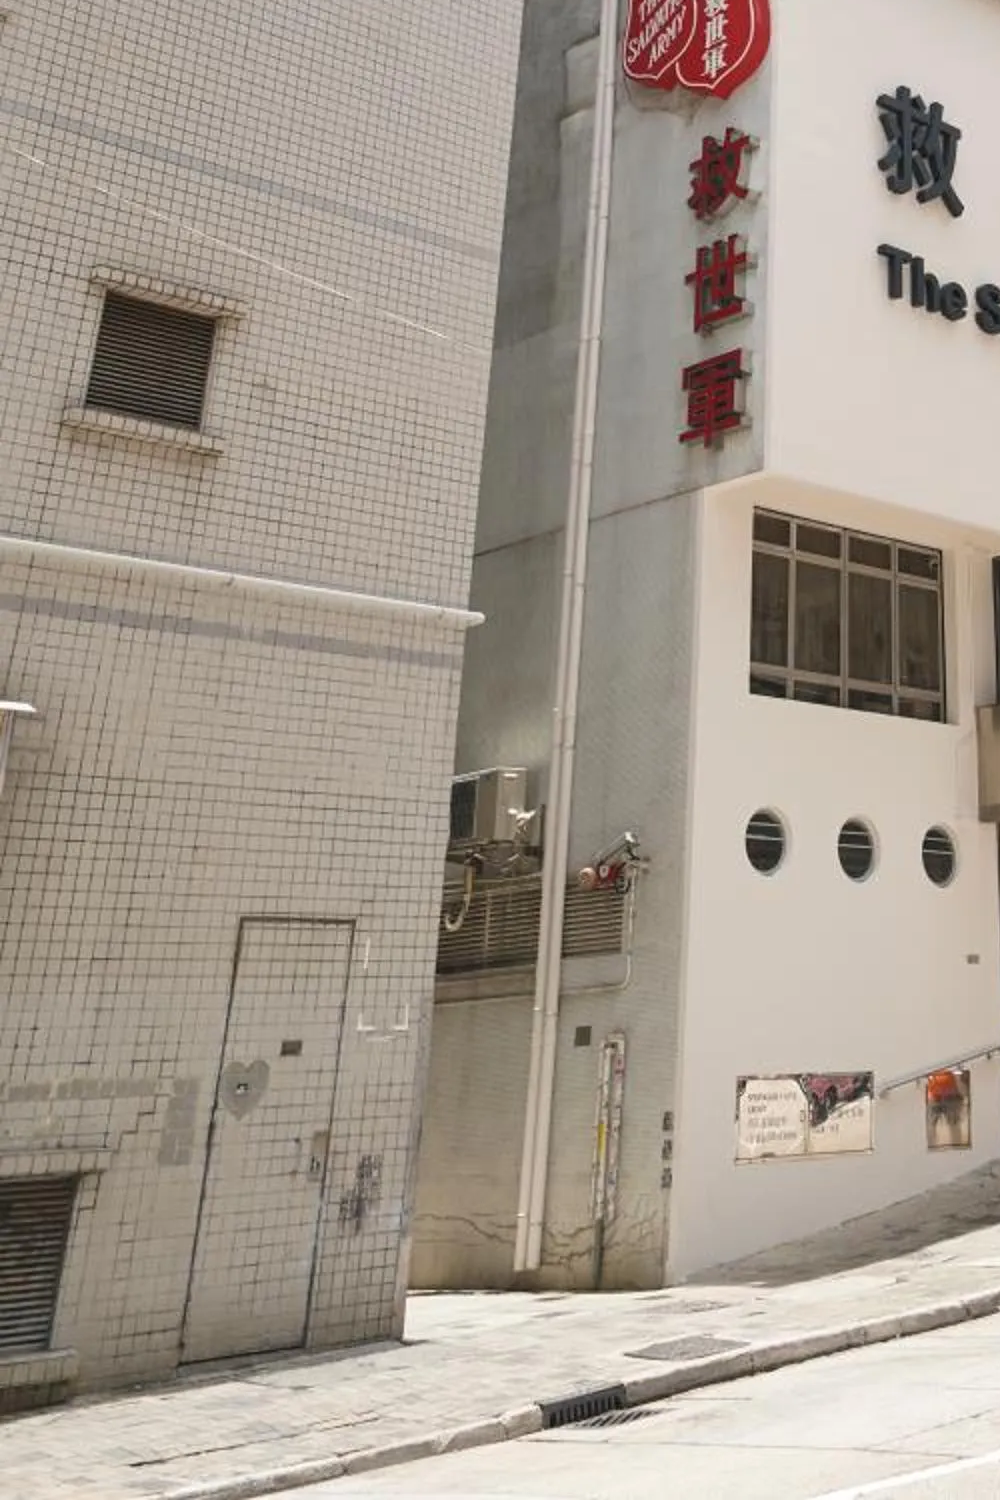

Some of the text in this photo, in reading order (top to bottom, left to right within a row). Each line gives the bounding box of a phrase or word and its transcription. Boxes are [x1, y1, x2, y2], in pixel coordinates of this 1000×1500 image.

[648, 5, 687, 69] ARMY
[678, 126, 758, 449] 救世軍
[877, 243, 967, 321] The
